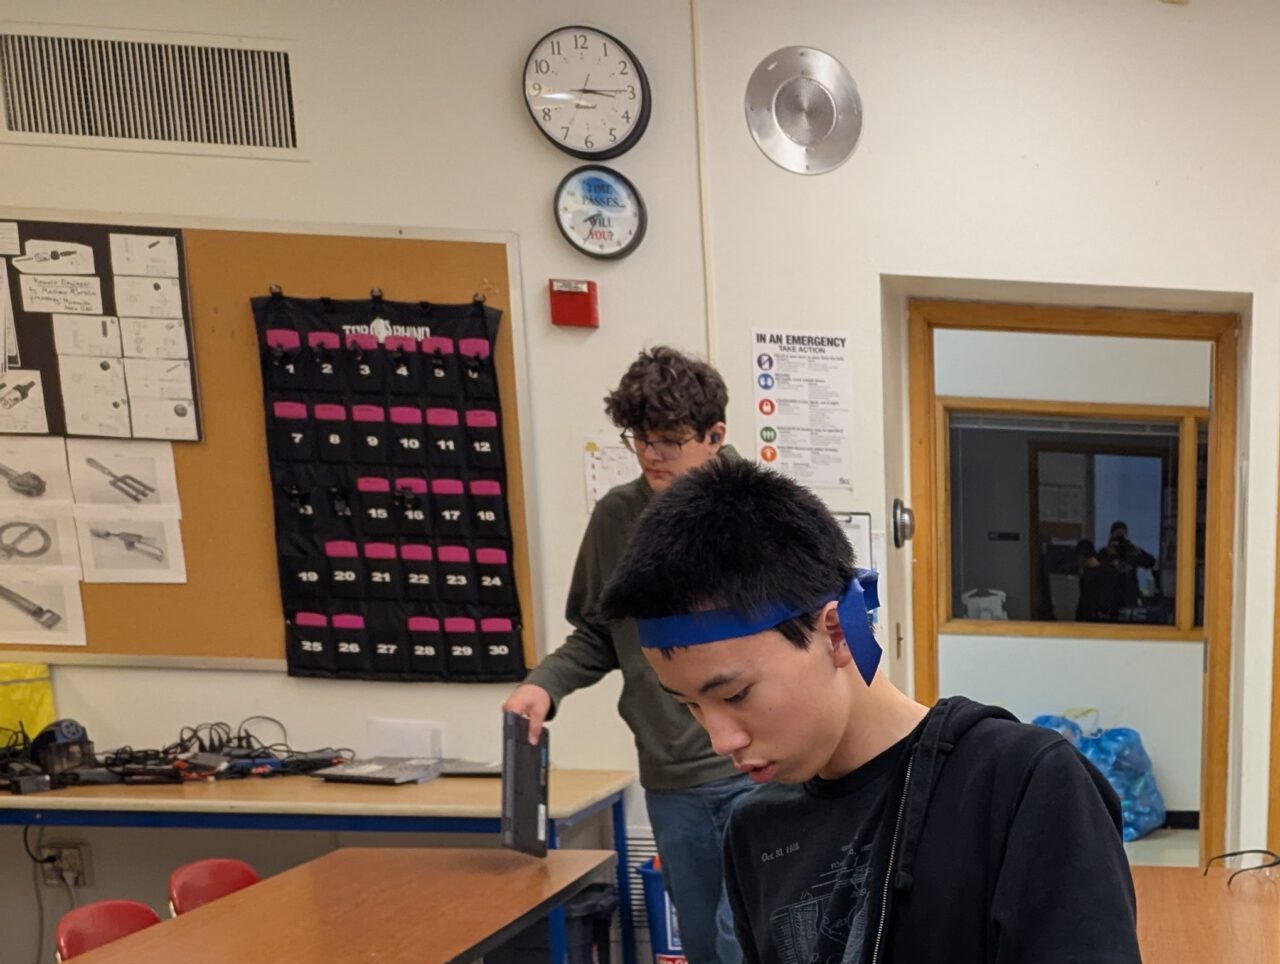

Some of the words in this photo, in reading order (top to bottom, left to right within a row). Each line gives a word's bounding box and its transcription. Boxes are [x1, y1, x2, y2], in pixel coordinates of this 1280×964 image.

[551, 41, 562, 56] 11
[573, 34, 589, 50] 12
[534, 59, 550, 74] 10
[619, 61, 629, 75] 2
[532, 82, 542, 97] 9
[627, 85, 637, 100] 3
[542, 108, 552, 121] 8
[621, 110, 631, 124] 4
[560, 126, 570, 141] 7
[609, 128, 617, 143] 5
[584, 135, 594, 149] 6
[755, 333, 767, 344] IN
[768, 334, 783, 345] AN
[786, 335, 846, 348] EMERGENCY
[778, 345, 797, 353] TAKE
[798, 346, 826, 354] ACTION
[321, 364, 333, 374] 2
[359, 365, 371, 375] 3
[396, 367, 409, 376] 4
[434, 368, 445, 377] 5
[291, 433, 303, 443] 7
[329, 434, 341, 444] 8
[366, 436, 379, 446] 9
[400, 438, 420, 448] 10
[436, 440, 455, 450] 11
[473, 442, 491, 452] 12
[368, 509, 388, 518] 15
[404, 510, 424, 520] 16
[441, 511, 461, 520] 17
[477, 511, 496, 521] 18
[298, 571, 319, 581] 19
[333, 571, 356, 581] 20
[371, 572, 391, 582] 21
[408, 574, 430, 584] 22
[446, 575, 467, 585] 23
[481, 576, 502, 586] 24
[301, 641, 323, 651] 25
[338, 643, 360, 653] 26
[376, 644, 398, 654] 27
[414, 646, 436, 656] 28
[452, 646, 473, 656] 29
[489, 645, 509, 655] 30
